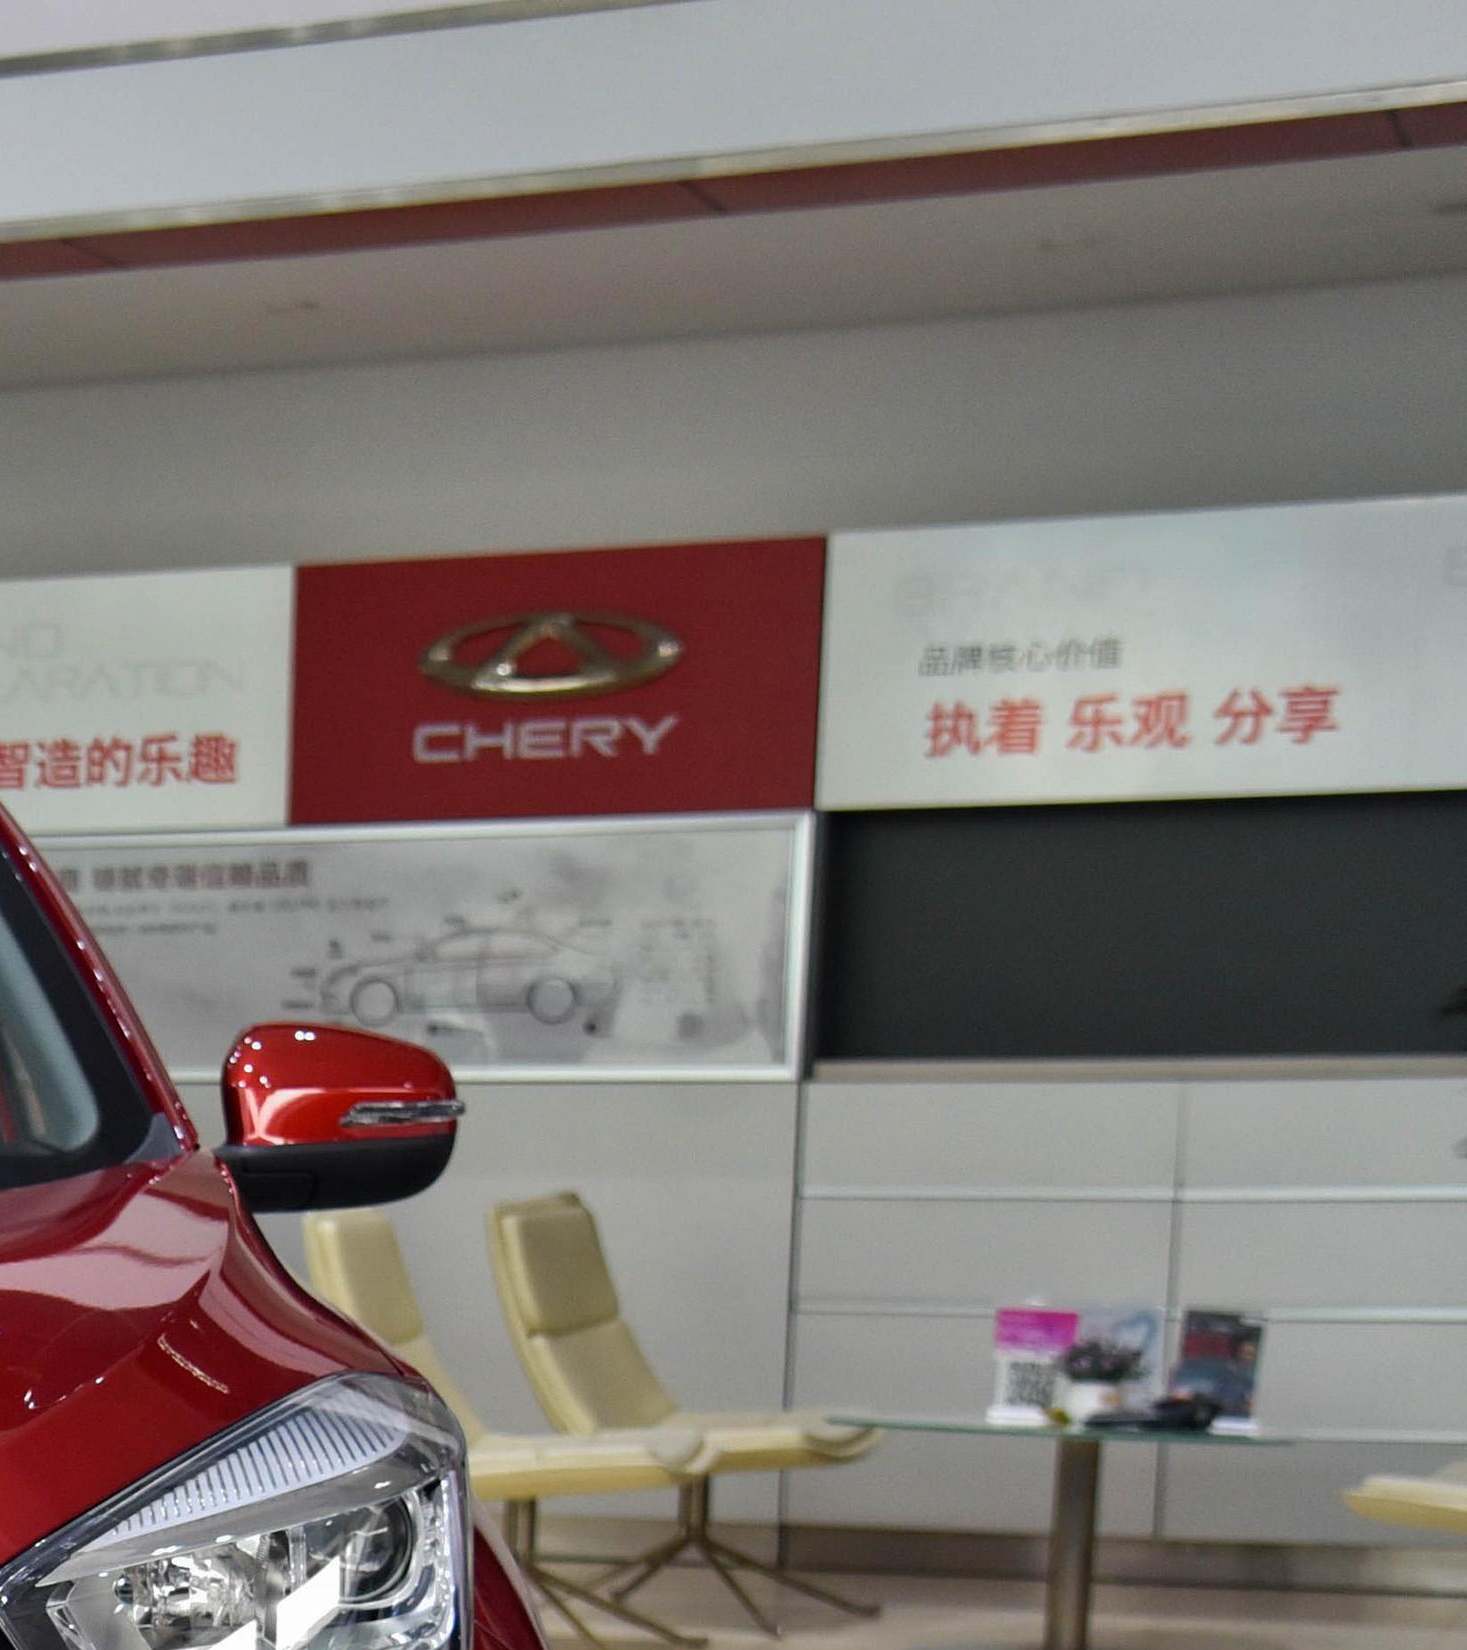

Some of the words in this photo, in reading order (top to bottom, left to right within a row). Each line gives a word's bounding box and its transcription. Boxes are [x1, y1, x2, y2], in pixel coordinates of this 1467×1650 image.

[413, 713, 678, 765] CHERY
[925, 697, 1045, 759] 执着
[1066, 691, 1191, 751] 乐观
[1213, 684, 1342, 747] 分享
